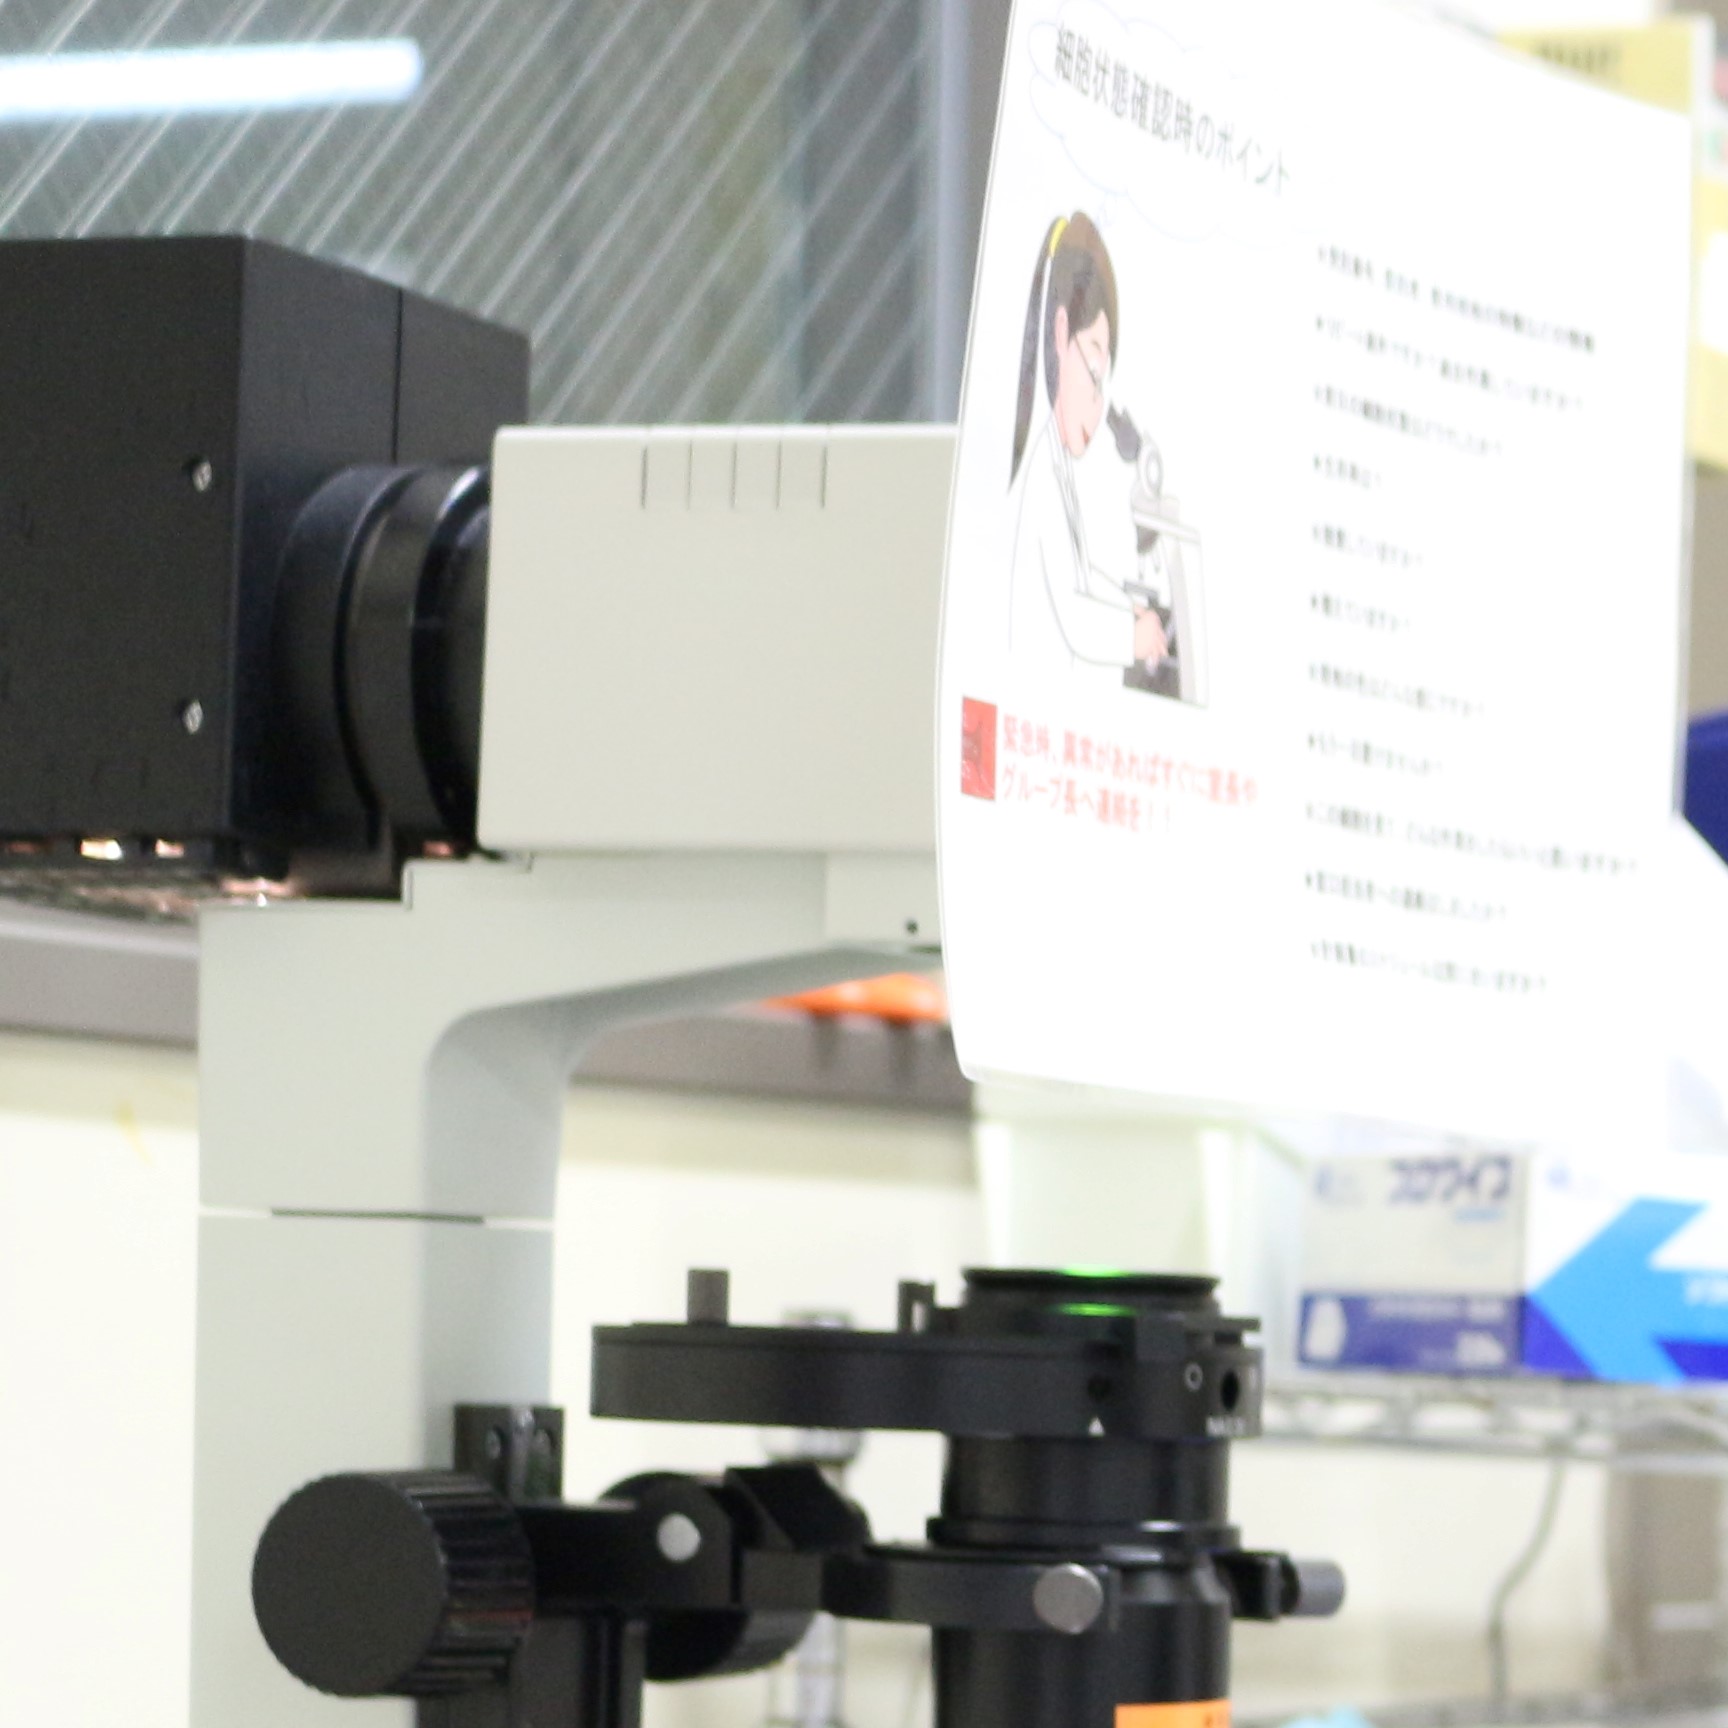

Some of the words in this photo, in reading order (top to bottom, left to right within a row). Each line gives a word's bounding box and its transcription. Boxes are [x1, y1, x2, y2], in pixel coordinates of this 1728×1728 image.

[1055, 21, 1291, 197] 細胞状態確認時のポイント
